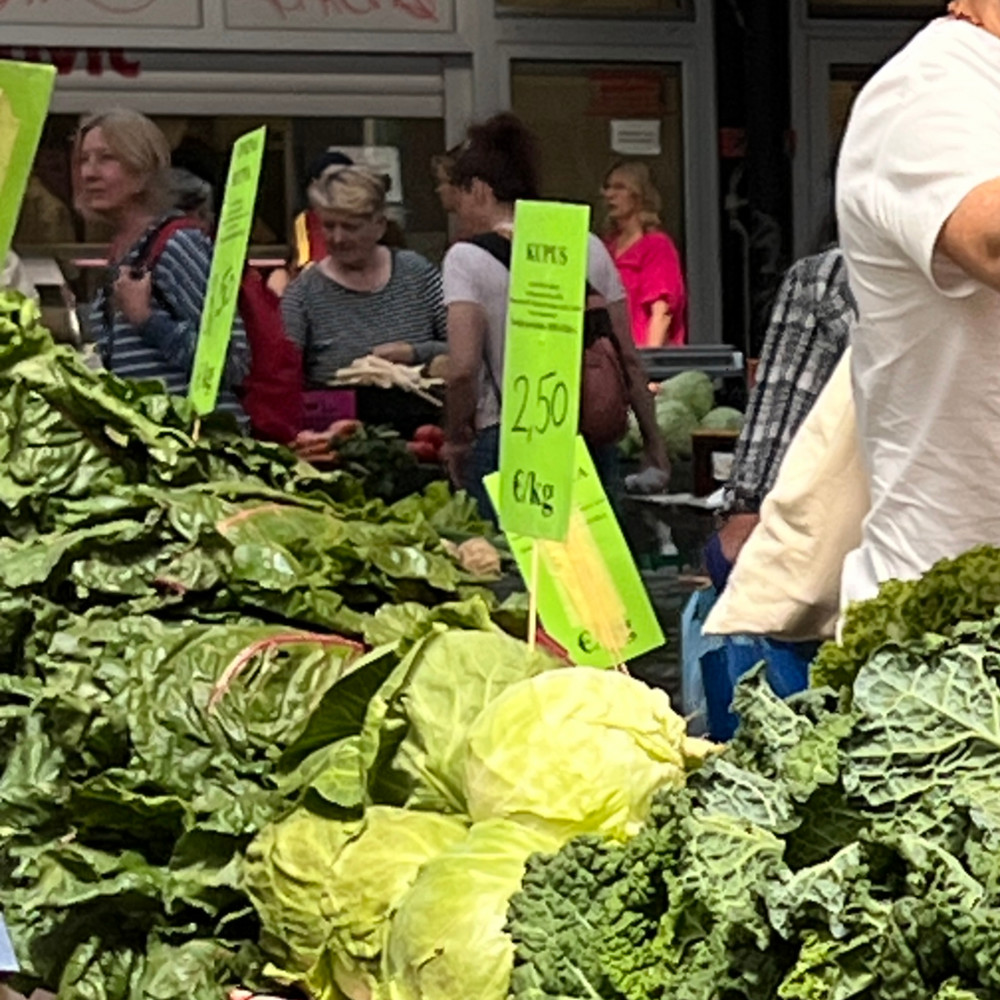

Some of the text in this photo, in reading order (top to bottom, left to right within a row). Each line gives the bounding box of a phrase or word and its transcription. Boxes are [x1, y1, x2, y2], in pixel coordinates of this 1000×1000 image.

[526, 243, 568, 266] KUPUS
[510, 371, 569, 443] 2,50
[512, 469, 555, 518] €/kg
